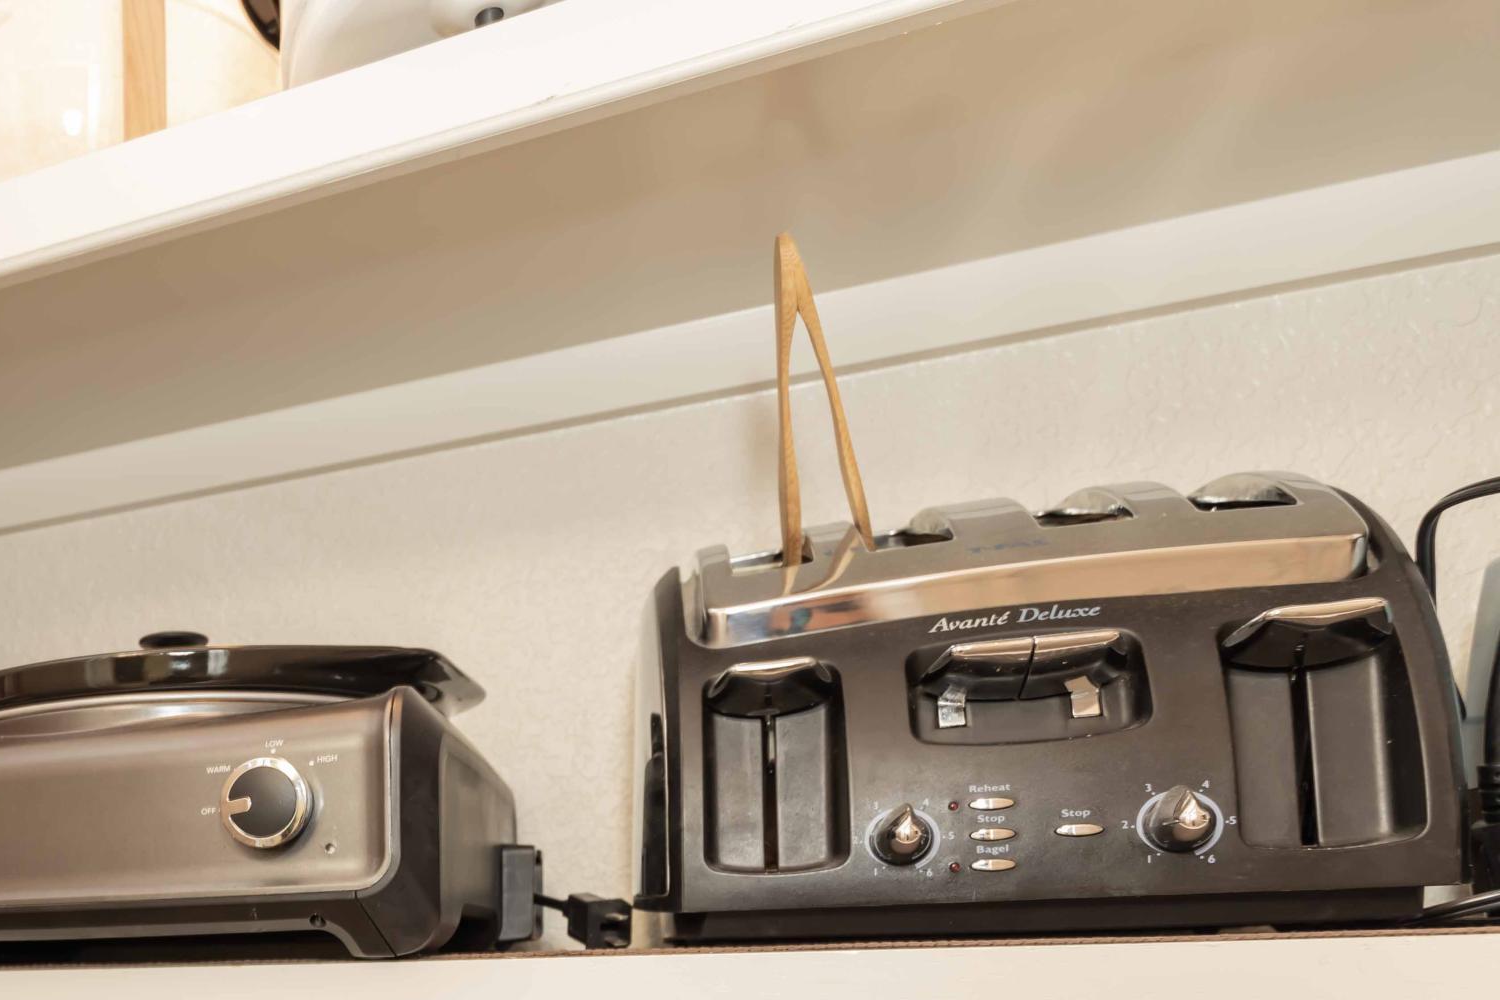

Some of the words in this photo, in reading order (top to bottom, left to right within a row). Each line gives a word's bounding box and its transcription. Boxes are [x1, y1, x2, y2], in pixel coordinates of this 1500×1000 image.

[927, 611, 1011, 634] Avanté
[1016, 604, 1102, 623] Deluxe
[265, 739, 284, 748] LOW
[316, 754, 338, 764] HIGH
[206, 765, 231, 775] WARM
[968, 784, 1011, 793] Reheat
[1061, 809, 1091, 818] Stop
[977, 815, 1005, 824] Stop
[976, 844, 1010, 856] Bagel
